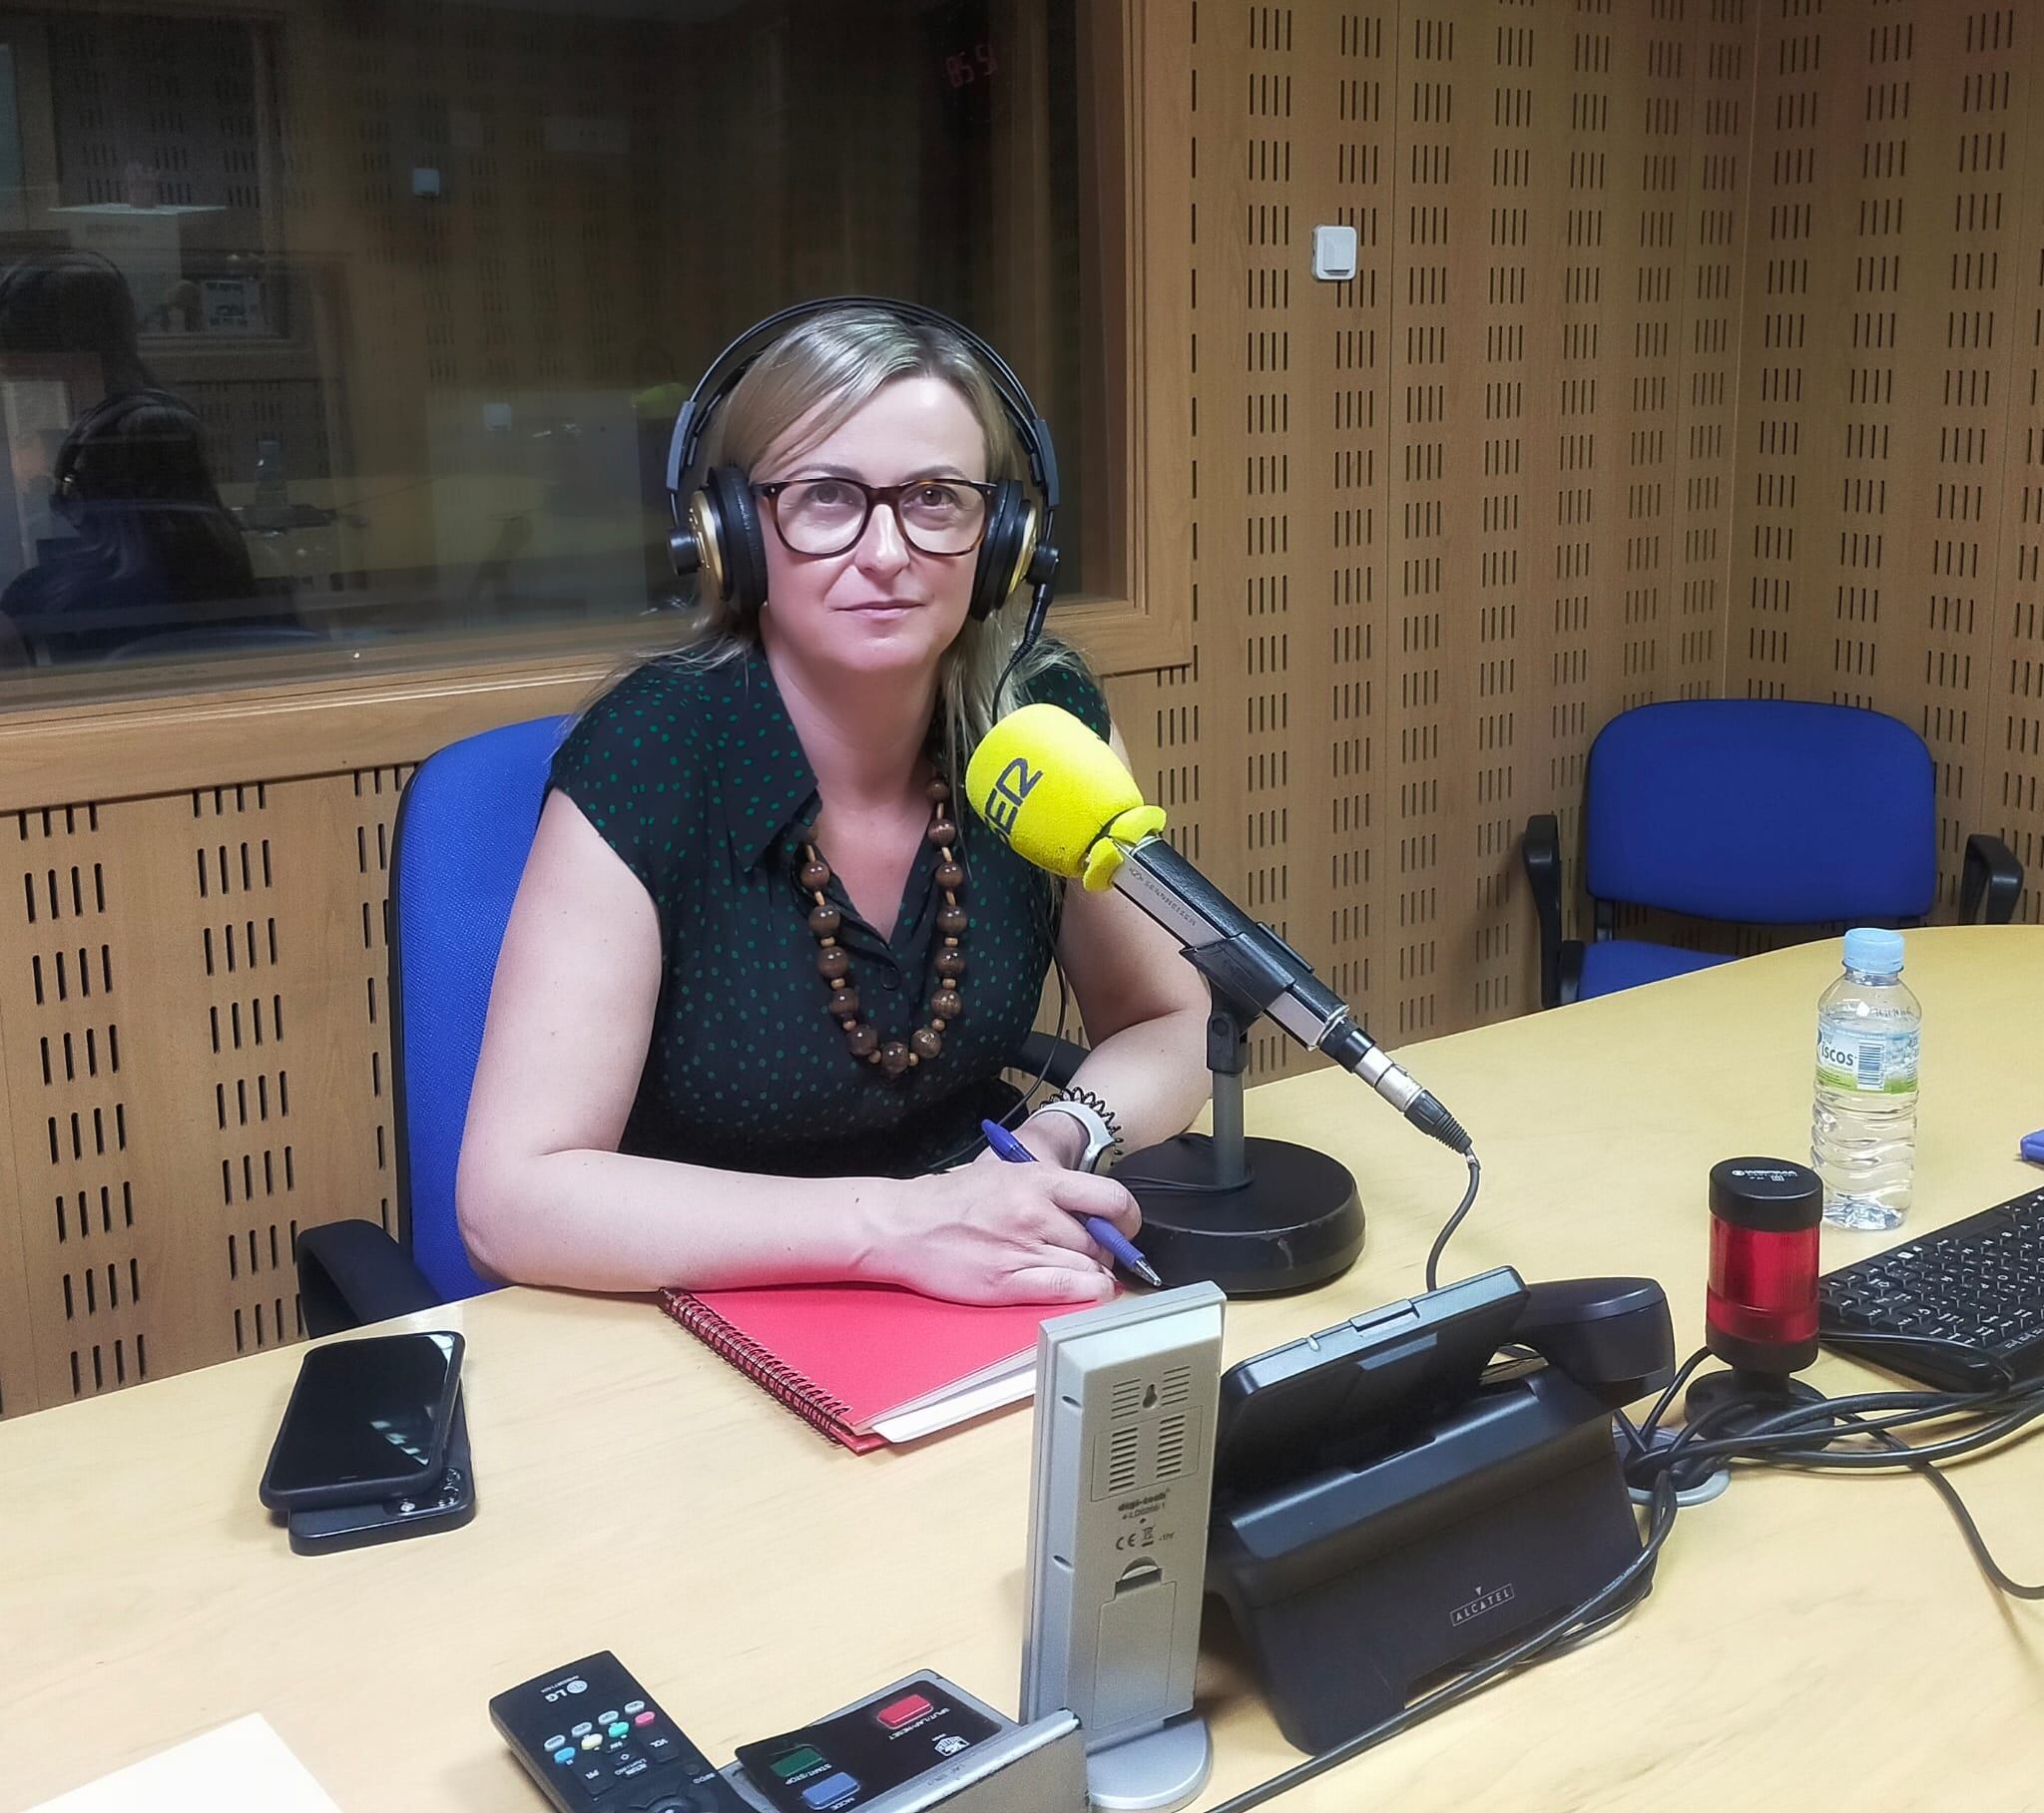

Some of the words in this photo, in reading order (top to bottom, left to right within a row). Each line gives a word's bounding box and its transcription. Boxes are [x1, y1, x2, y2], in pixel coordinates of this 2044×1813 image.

[984, 757, 1044, 837] ER
[1456, 1588, 1510, 1622] ALCATEL
[545, 1686, 568, 1702] LG
[650, 1738, 669, 1748] VOL
[831, 1797, 855, 1811] MODE
